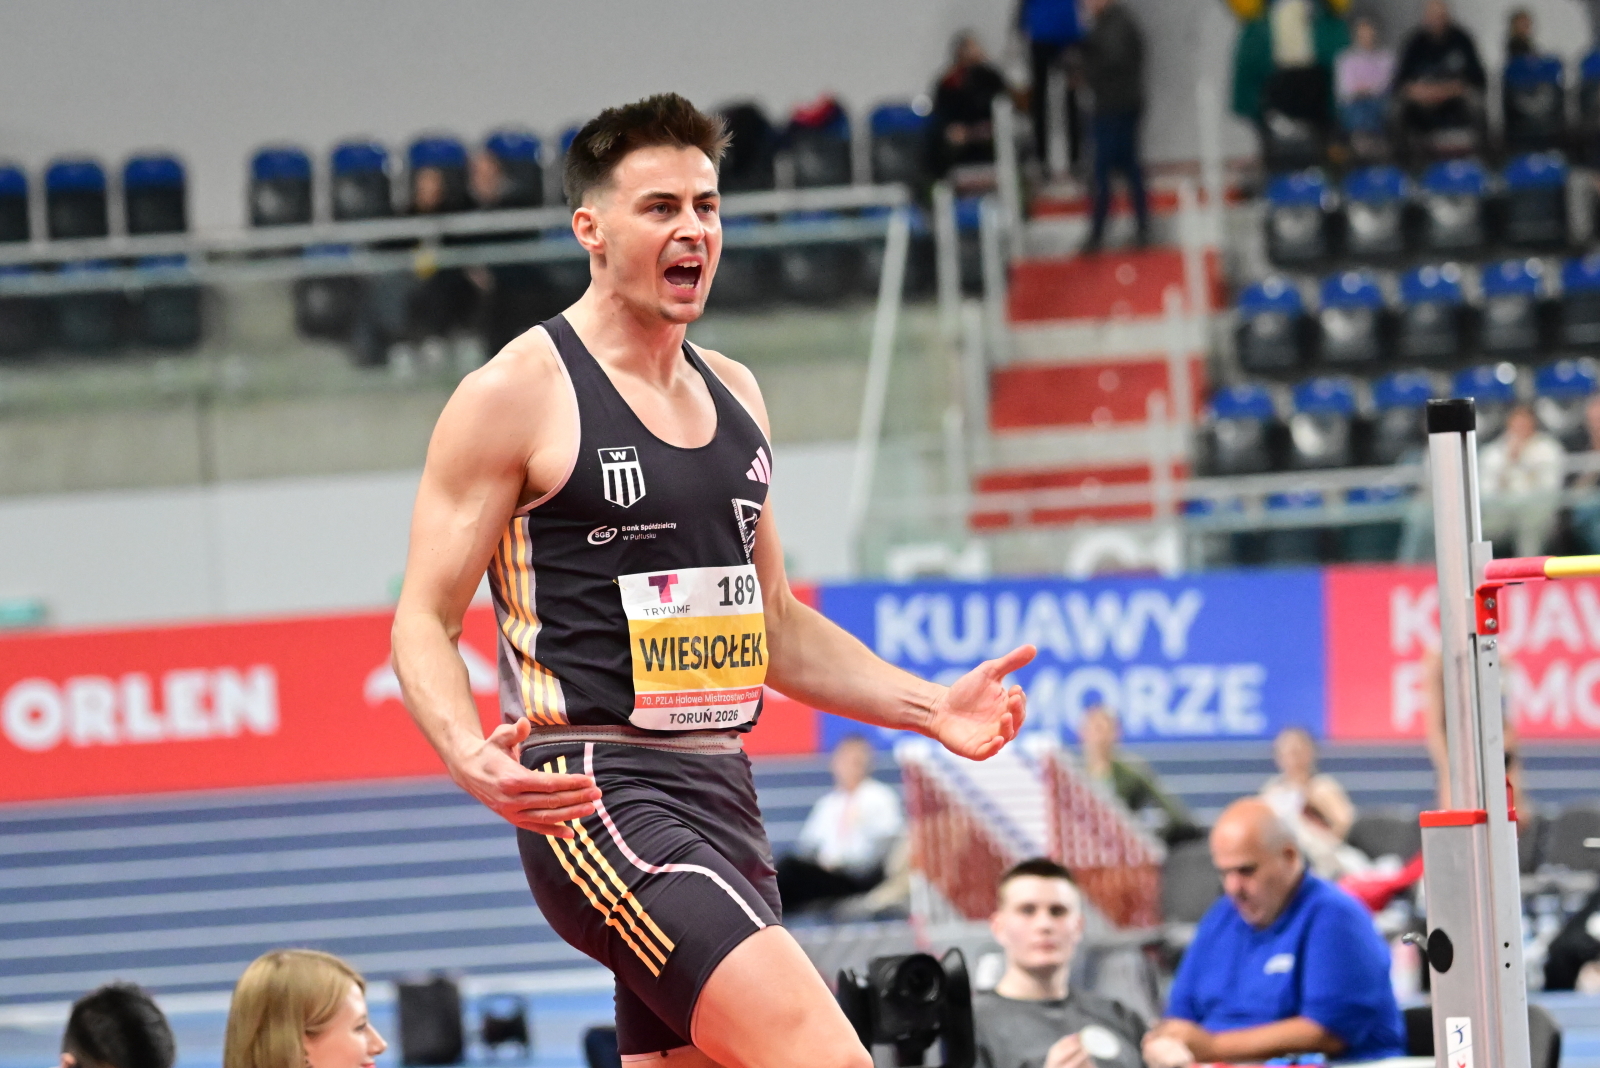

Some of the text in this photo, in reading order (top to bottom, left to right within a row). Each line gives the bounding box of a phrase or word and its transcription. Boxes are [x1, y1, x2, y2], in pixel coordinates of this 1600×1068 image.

[608, 451, 627, 461] W
[621, 522, 677, 532] Bank Spółdzielczy
[717, 574, 756, 607] 189
[643, 604, 691, 617] TRYUMF
[875, 589, 1203, 664] KUJAWY
[639, 632, 763, 672] WIESIOŁEK
[2, 664, 278, 750] ORLEN
[641, 696, 654, 706] 70.
[655, 696, 674, 705] PZLA
[675, 694, 703, 705] Halowe
[704, 692, 745, 703] Mistrzostwa
[669, 708, 739, 724] TORUŃ 2026
